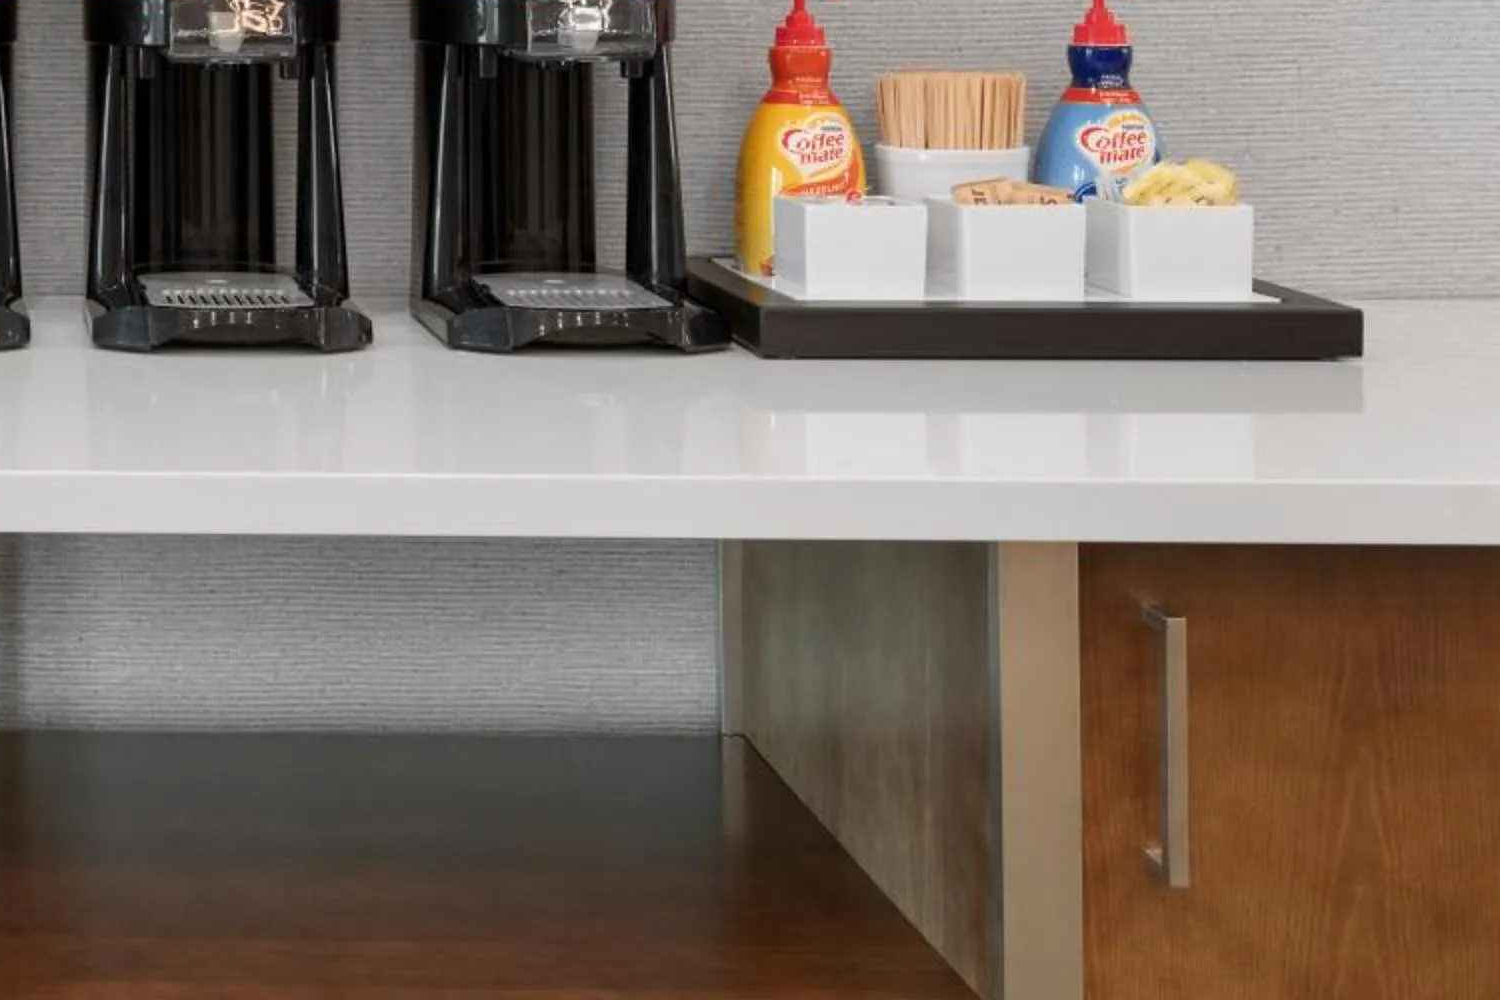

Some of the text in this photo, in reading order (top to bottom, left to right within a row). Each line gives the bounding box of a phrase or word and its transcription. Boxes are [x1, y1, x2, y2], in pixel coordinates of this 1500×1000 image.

[781, 129, 845, 154] Coffee
[1080, 127, 1148, 153] Coffee
[800, 148, 844, 164] mate
[1100, 147, 1146, 165] mate
